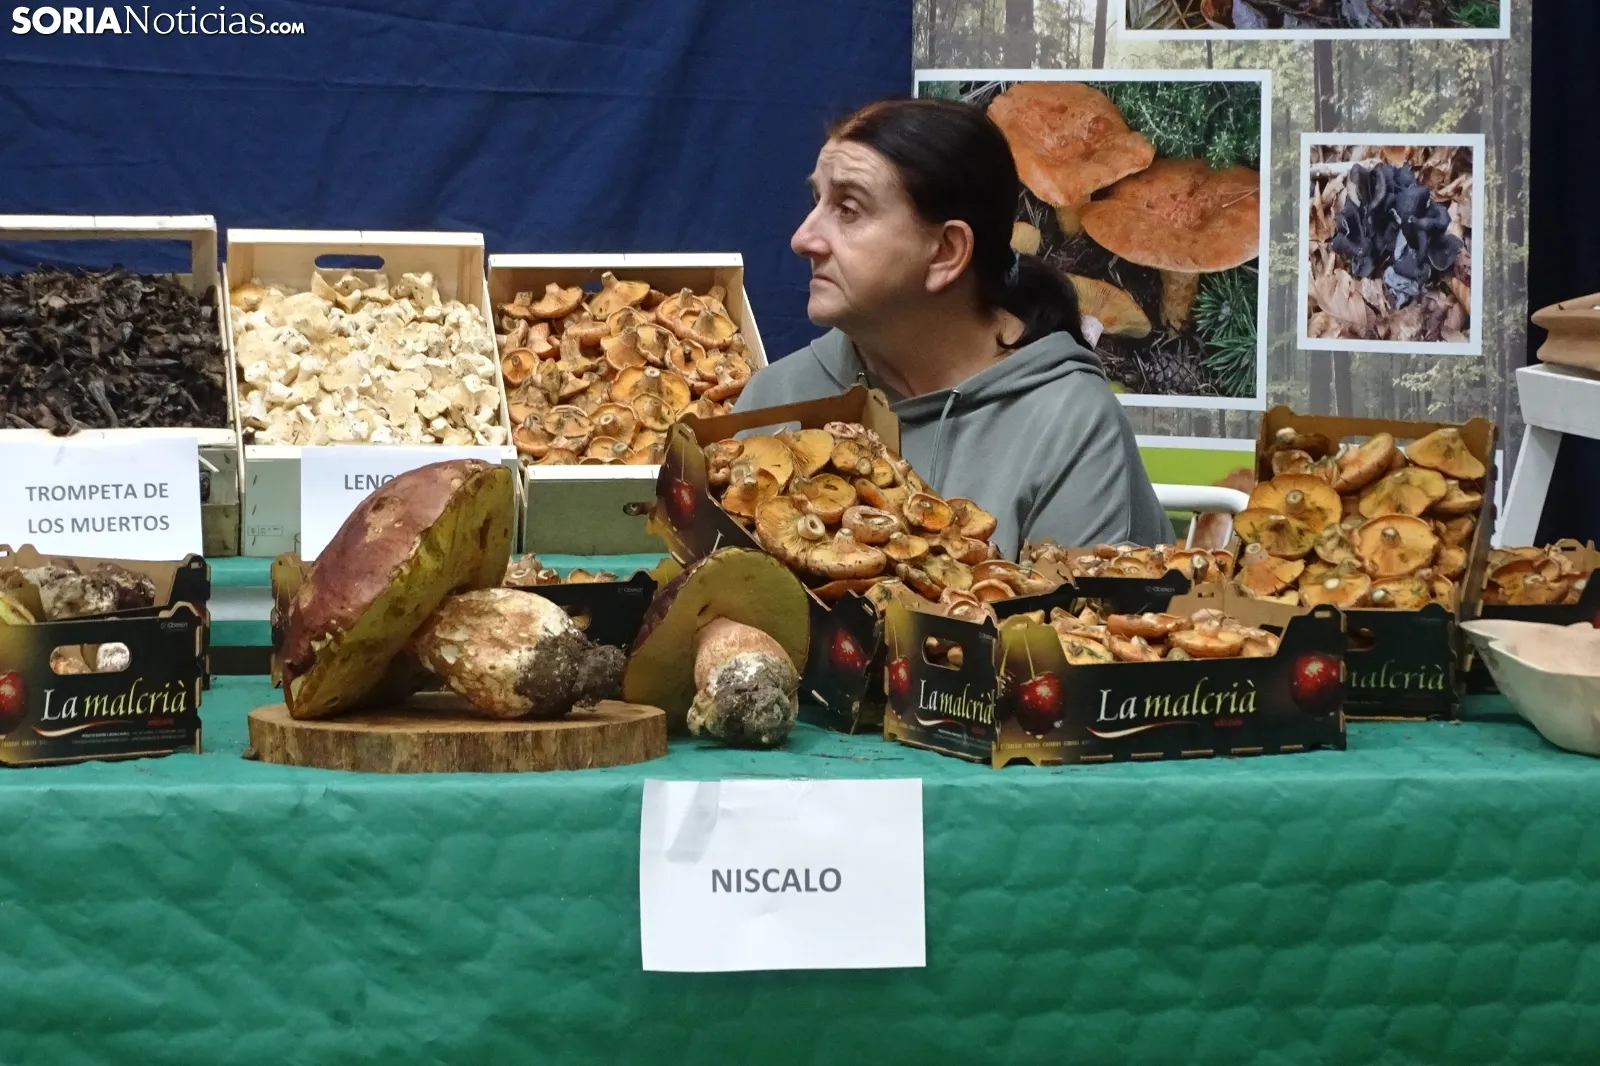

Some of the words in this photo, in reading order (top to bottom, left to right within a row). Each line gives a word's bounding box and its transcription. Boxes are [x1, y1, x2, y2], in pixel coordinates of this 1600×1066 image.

[25, 483, 138, 502] TROMPETA
[143, 482, 169, 499] DE
[28, 517, 64, 534] LOS
[71, 515, 170, 533] MUERTOS
[40, 689, 78, 722] La
[84, 677, 187, 718] malcrià
[919, 679, 938, 711] La
[1096, 689, 1137, 722] La
[1144, 677, 1257, 718] malcrià
[711, 867, 842, 893] NISCALO
